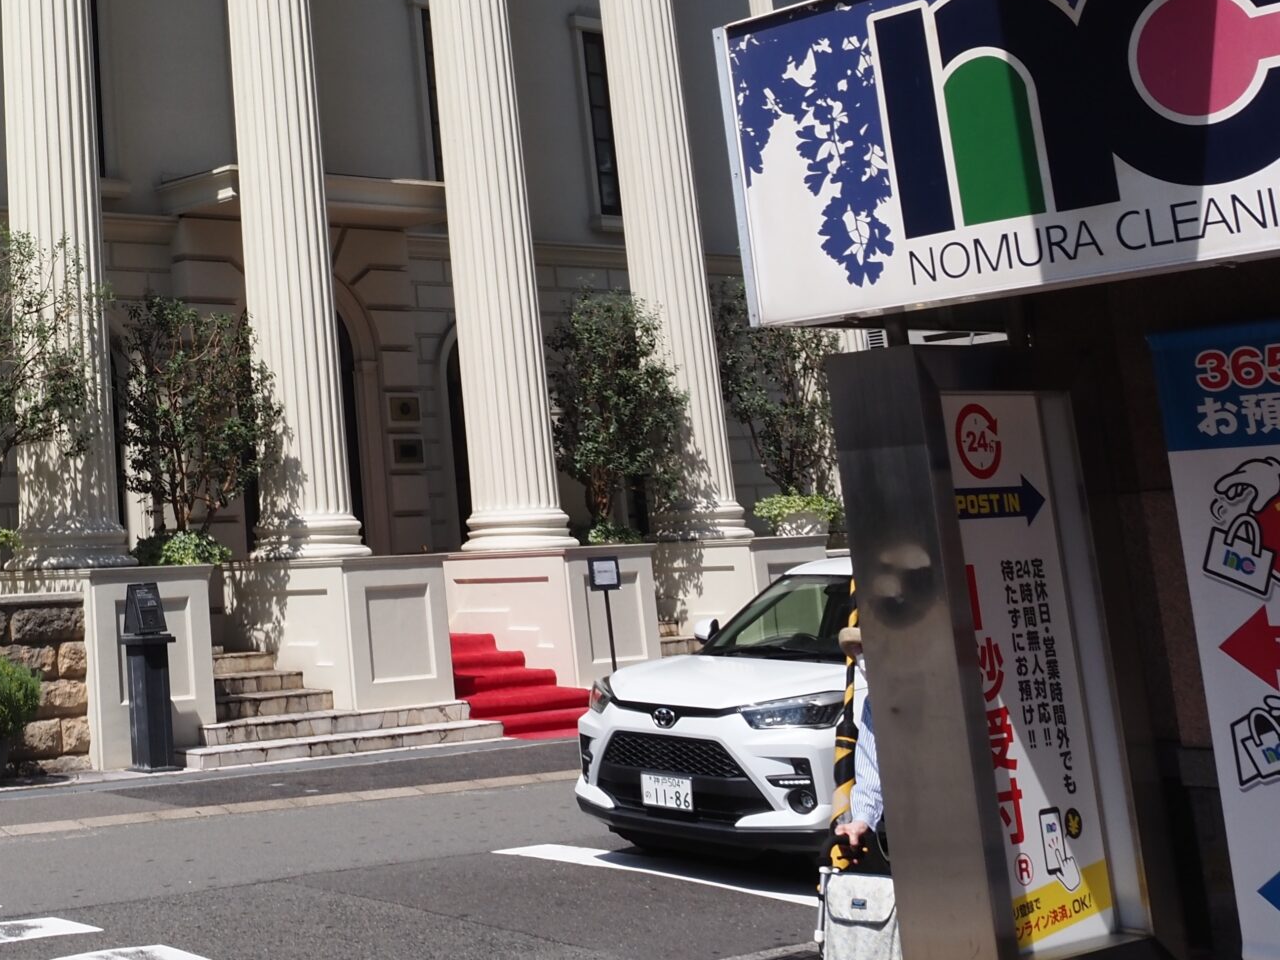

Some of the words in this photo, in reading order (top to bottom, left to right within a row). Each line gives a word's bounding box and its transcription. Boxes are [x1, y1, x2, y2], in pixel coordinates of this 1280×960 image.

[907, 219, 1104, 286] NOMURA
[955, 493, 1000, 515] POST
[1004, 493, 1021, 512] IN
